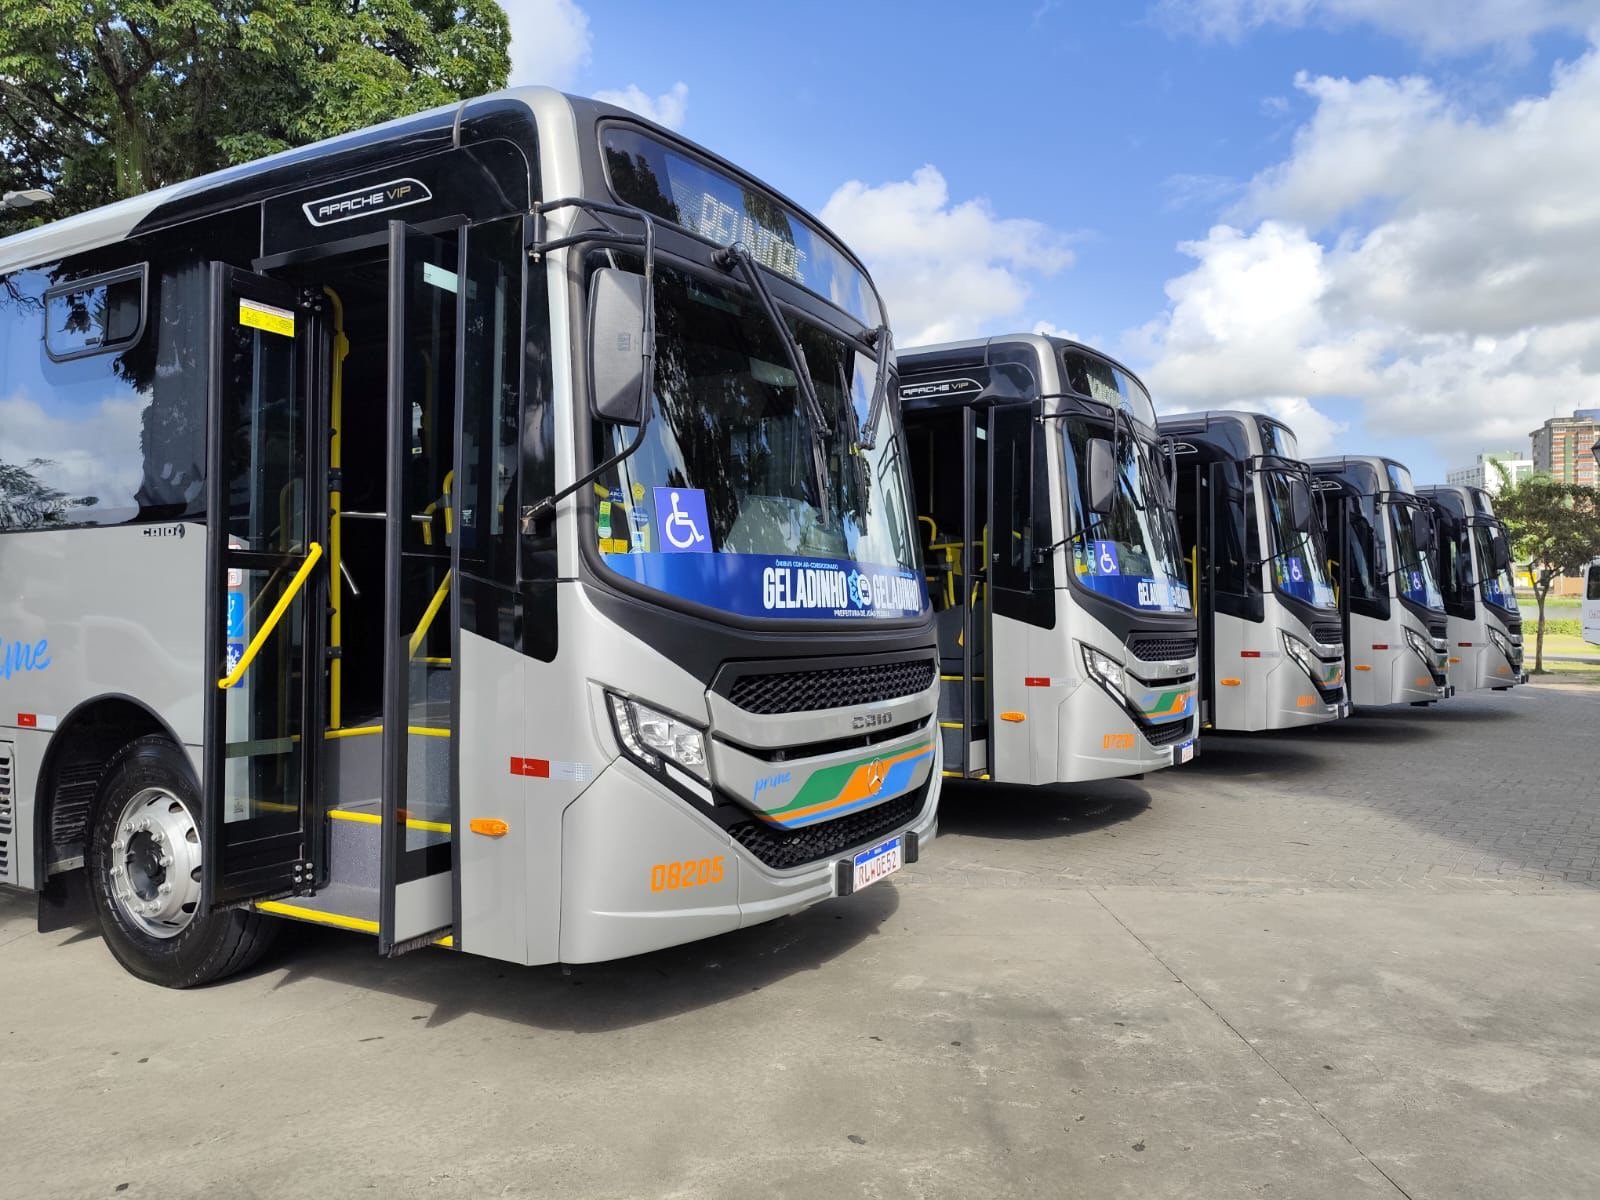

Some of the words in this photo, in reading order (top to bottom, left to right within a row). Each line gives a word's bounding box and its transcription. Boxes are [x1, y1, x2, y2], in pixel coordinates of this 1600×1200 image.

[319, 192, 384, 217] APACHE
[386, 185, 411, 200] VIP
[903, 384, 950, 396] APACHE
[951, 381, 969, 390] VIP
[763, 567, 849, 610] GELADINHO
[852, 711, 892, 729] CAIO
[650, 855, 725, 892] 08205
